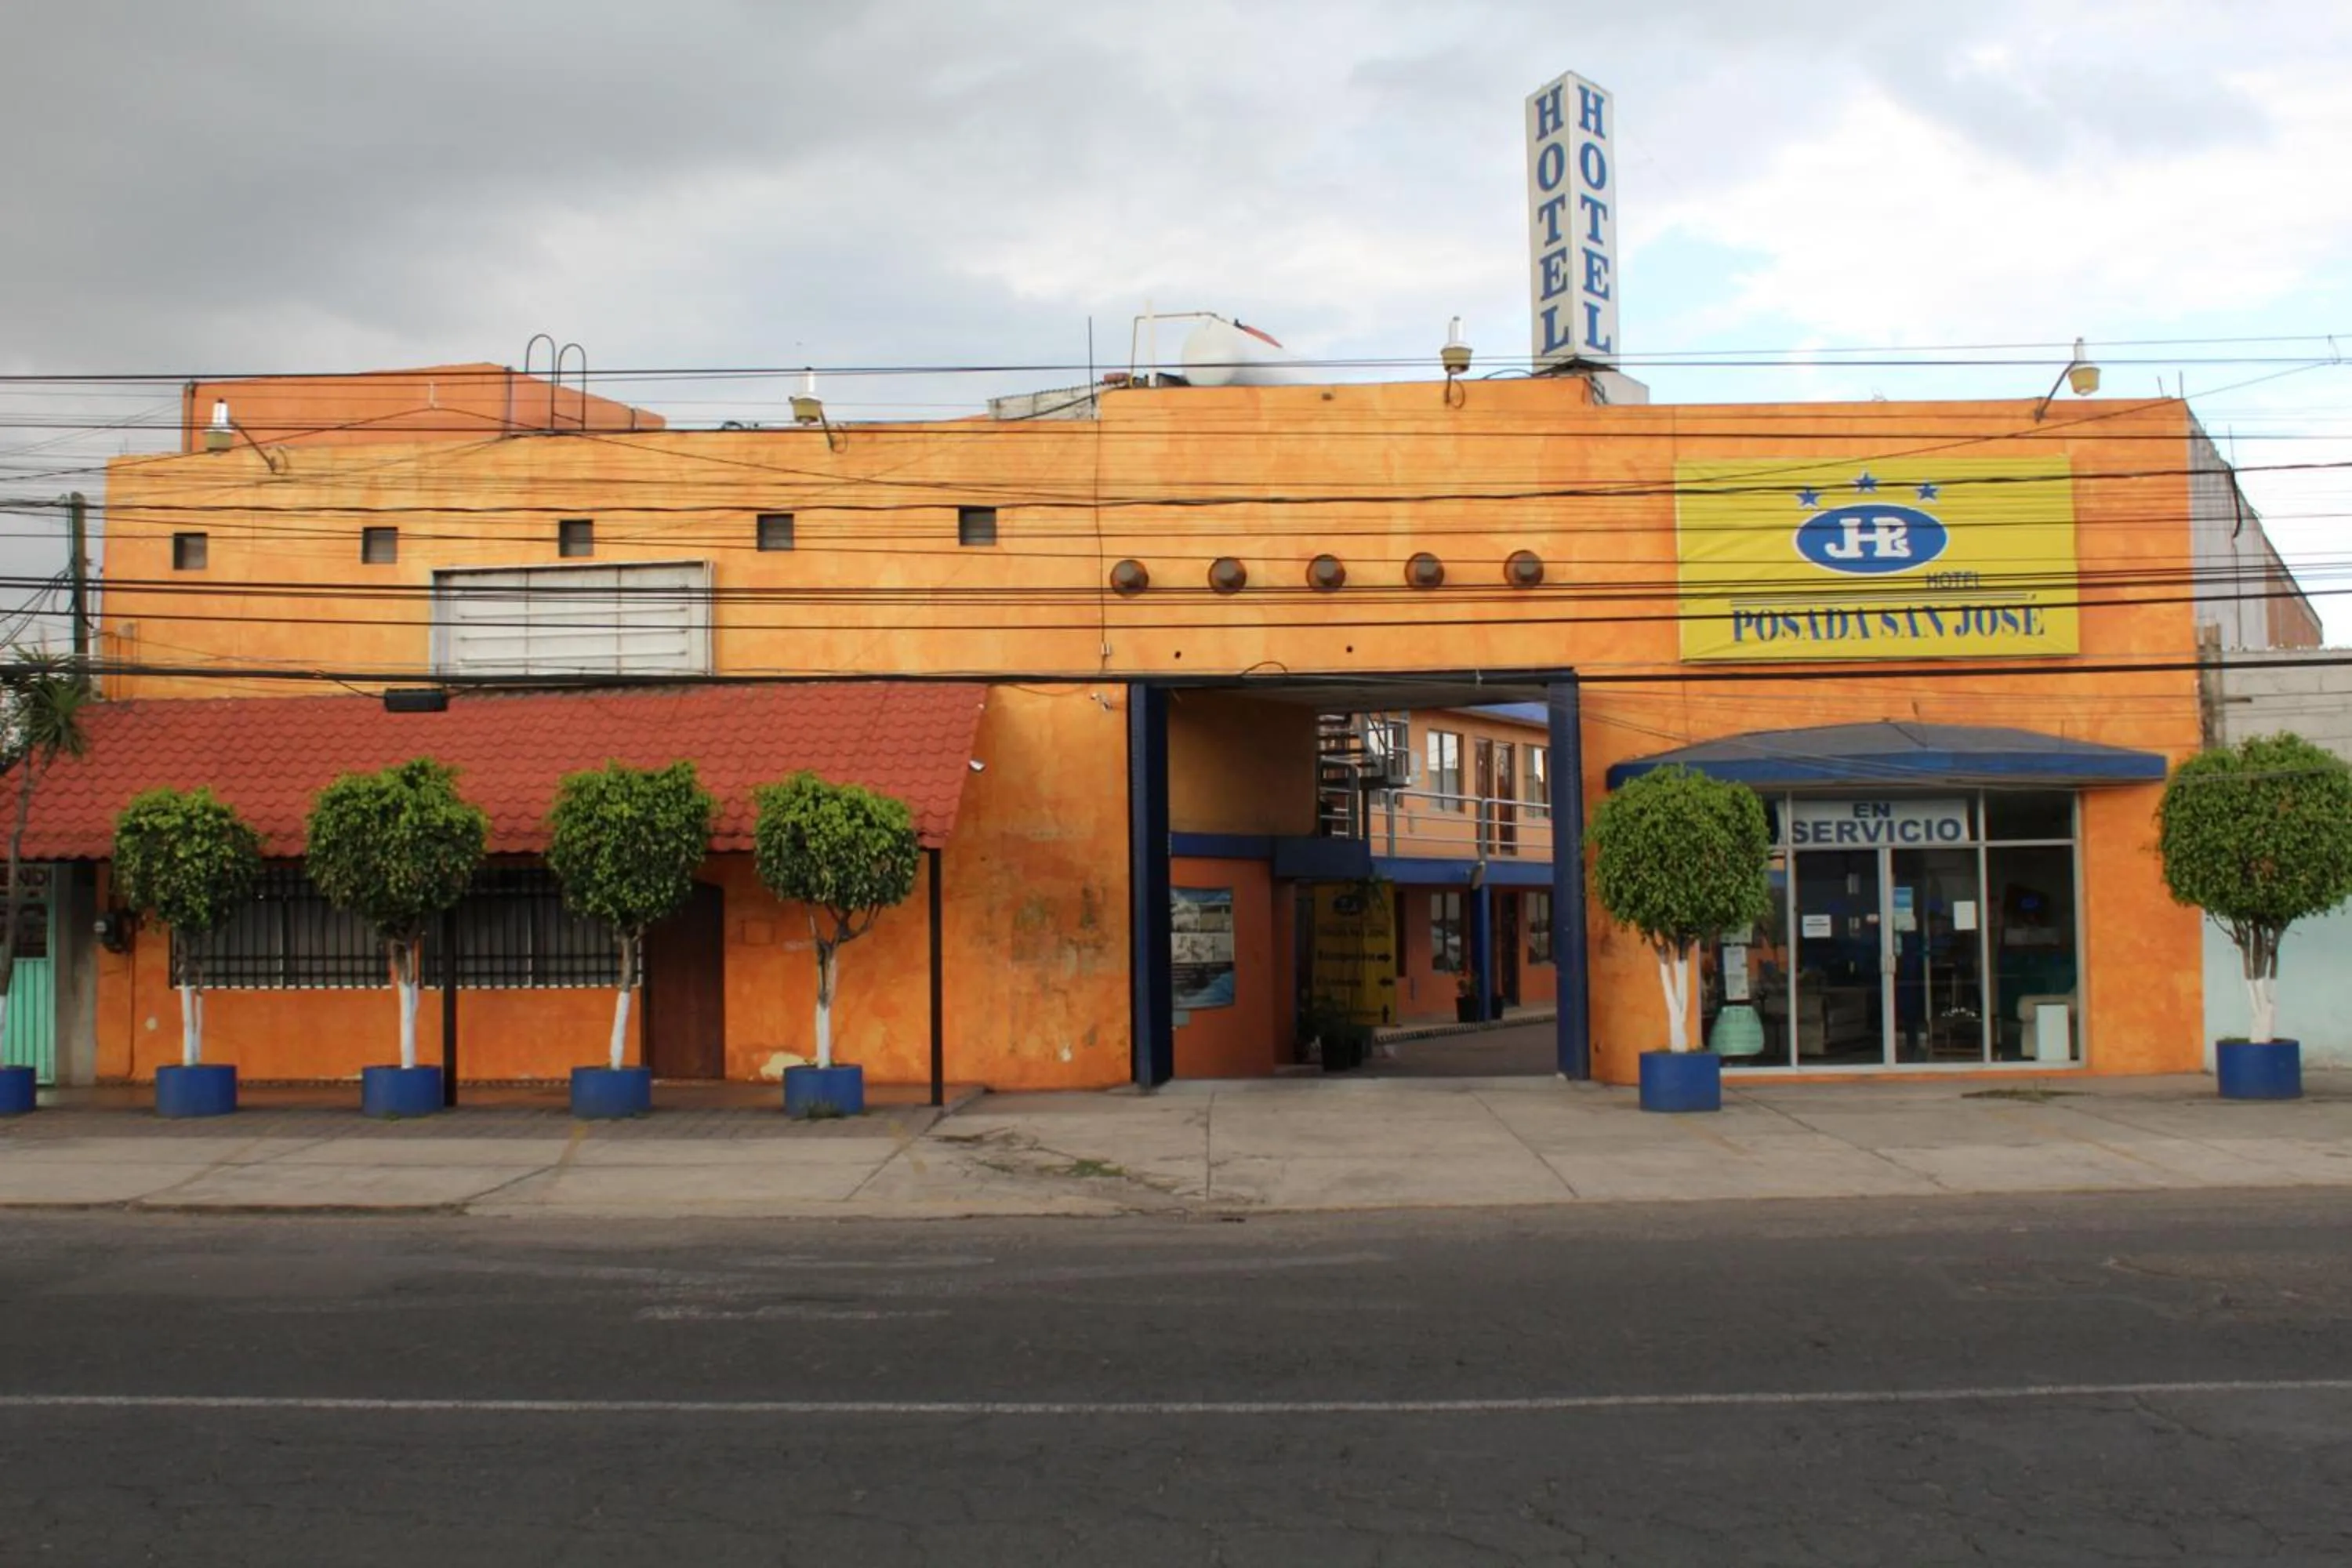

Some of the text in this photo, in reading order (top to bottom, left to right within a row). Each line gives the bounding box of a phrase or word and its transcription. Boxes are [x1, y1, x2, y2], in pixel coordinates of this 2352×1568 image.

[1534, 83, 1570, 356] HOTEL
[1577, 84, 1611, 354] HOTEL
[1926, 572, 1980, 590] HOTEL
[1733, 593, 2045, 642] POSADA SAN JOSÉ
[1853, 802, 1891, 818] EN
[1791, 818, 1962, 844] SERVICIO
